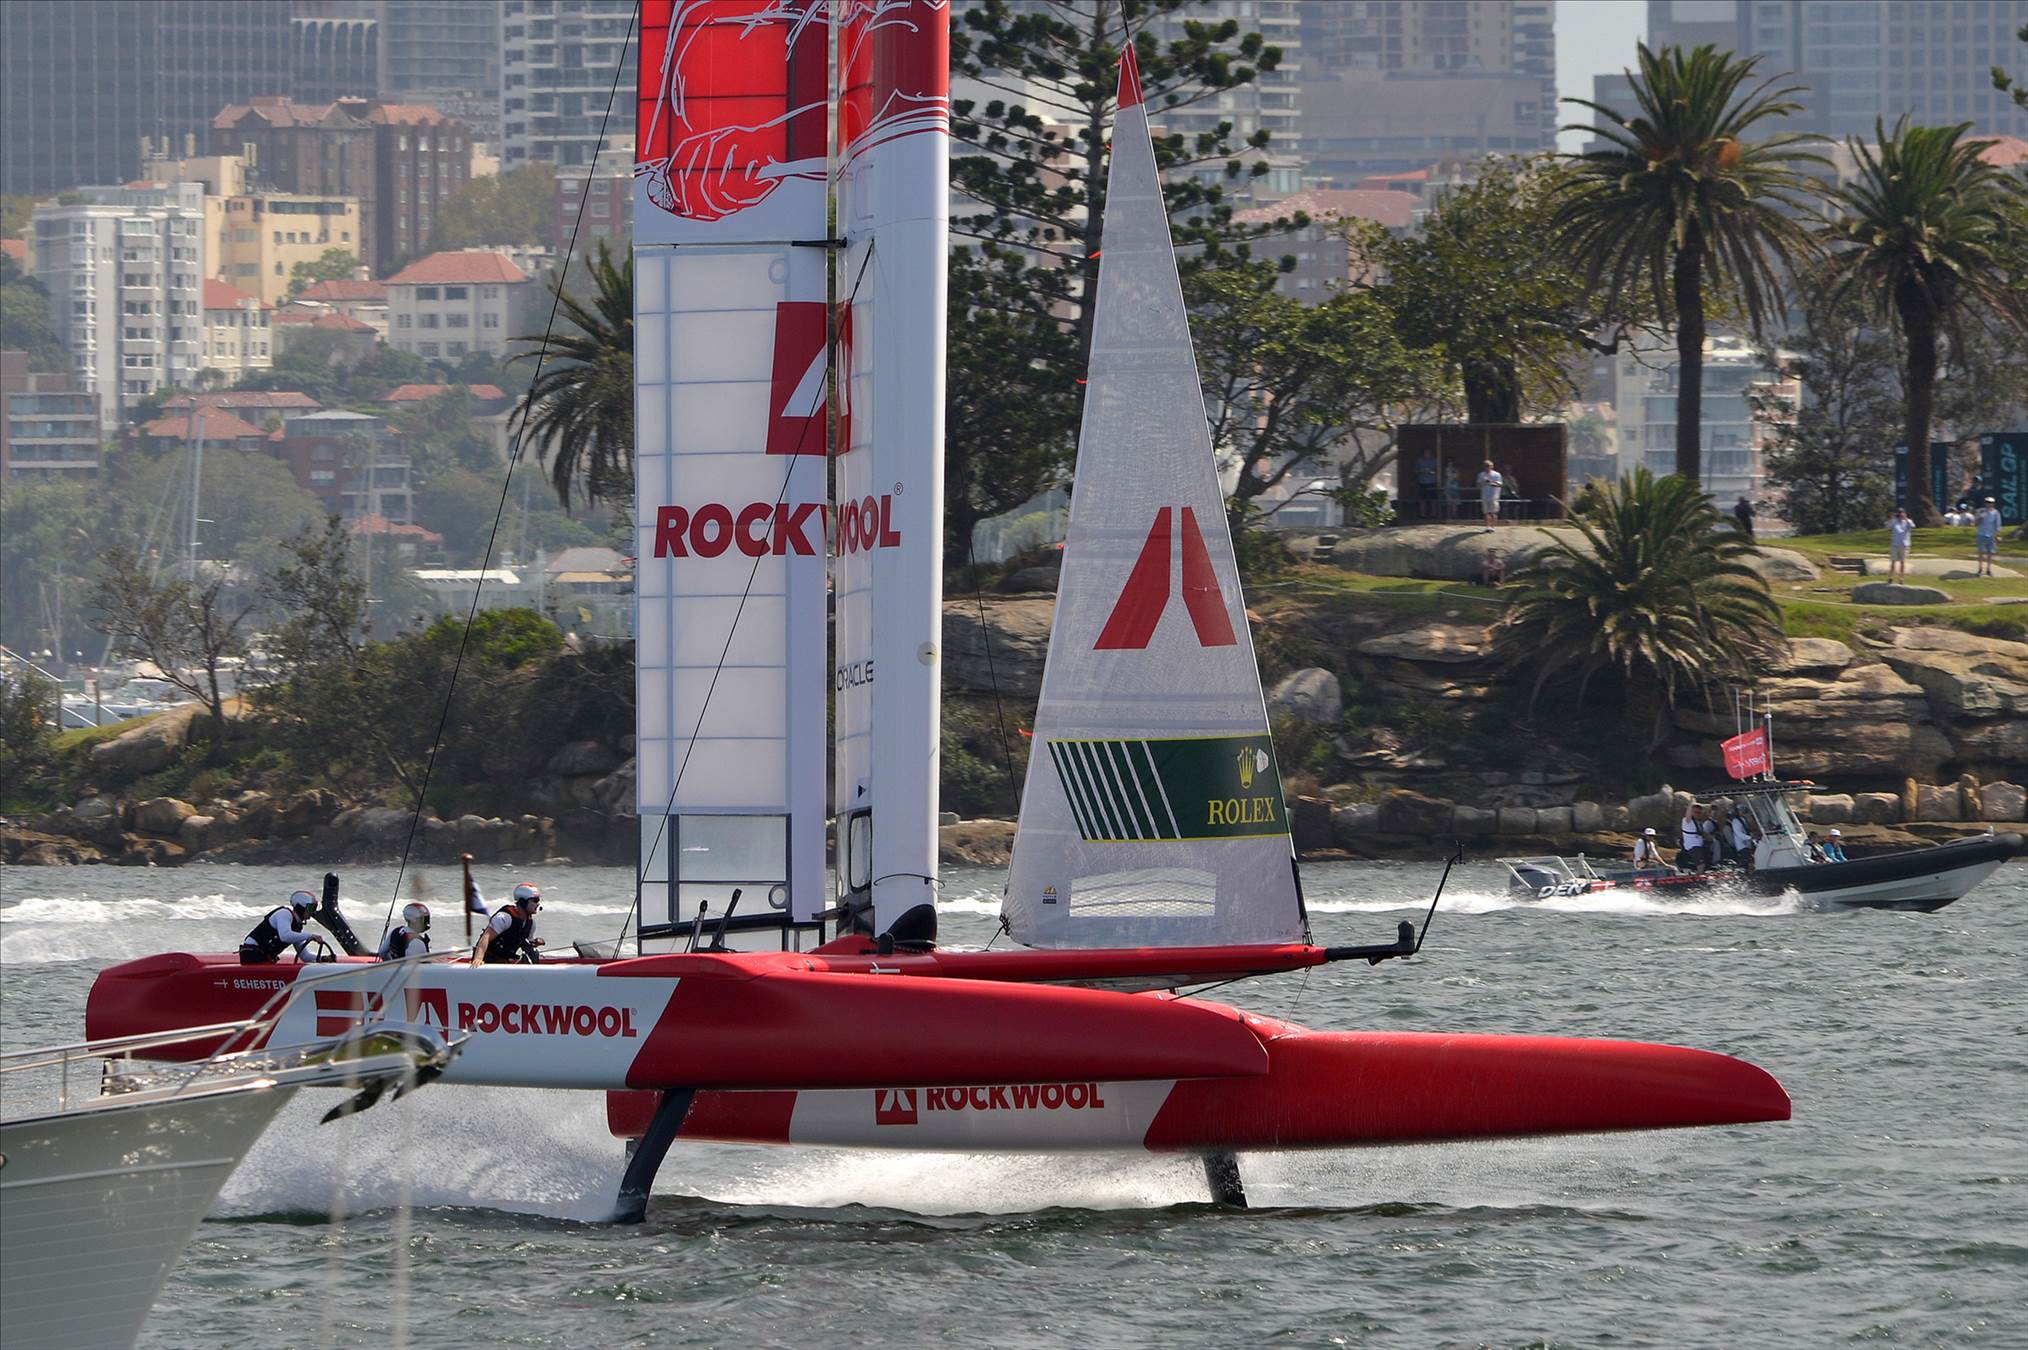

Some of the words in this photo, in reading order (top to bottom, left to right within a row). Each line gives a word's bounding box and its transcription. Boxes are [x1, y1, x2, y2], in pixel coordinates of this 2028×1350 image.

[836, 660, 874, 691] ORACLE
[1208, 797, 1276, 825] ROLEX
[1537, 883, 1588, 898] DEN
[233, 978, 286, 990] SEHESTED
[926, 1083, 1105, 1110] ROCKWOOL
